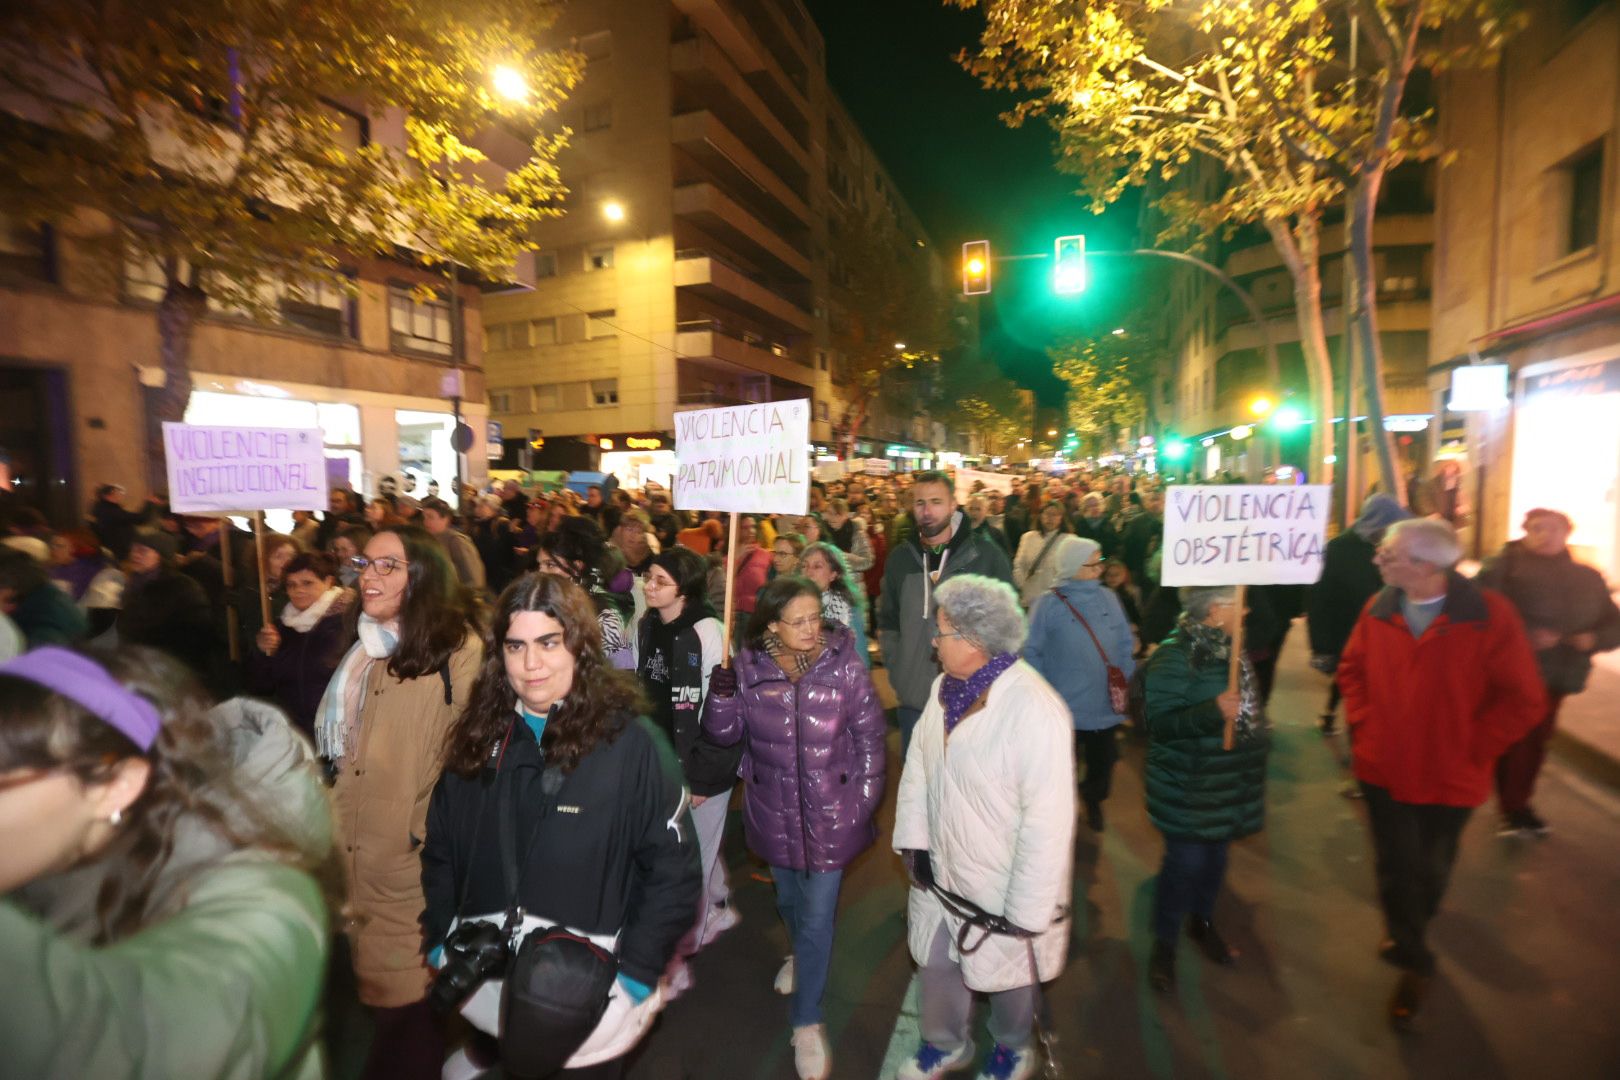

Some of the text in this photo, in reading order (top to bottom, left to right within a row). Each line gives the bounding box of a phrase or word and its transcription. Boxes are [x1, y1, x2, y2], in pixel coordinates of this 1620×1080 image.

[680, 405, 785, 441] VIOLENCIA
[170, 428, 289, 461] VIOLENCIA
[176, 463, 318, 497] INSTITUCIONAL
[678, 446, 801, 492] PATRIMONIAL
[1177, 490, 1316, 523] VIOLENCIA
[1174, 526, 1325, 566] OBSTÉTRICA
